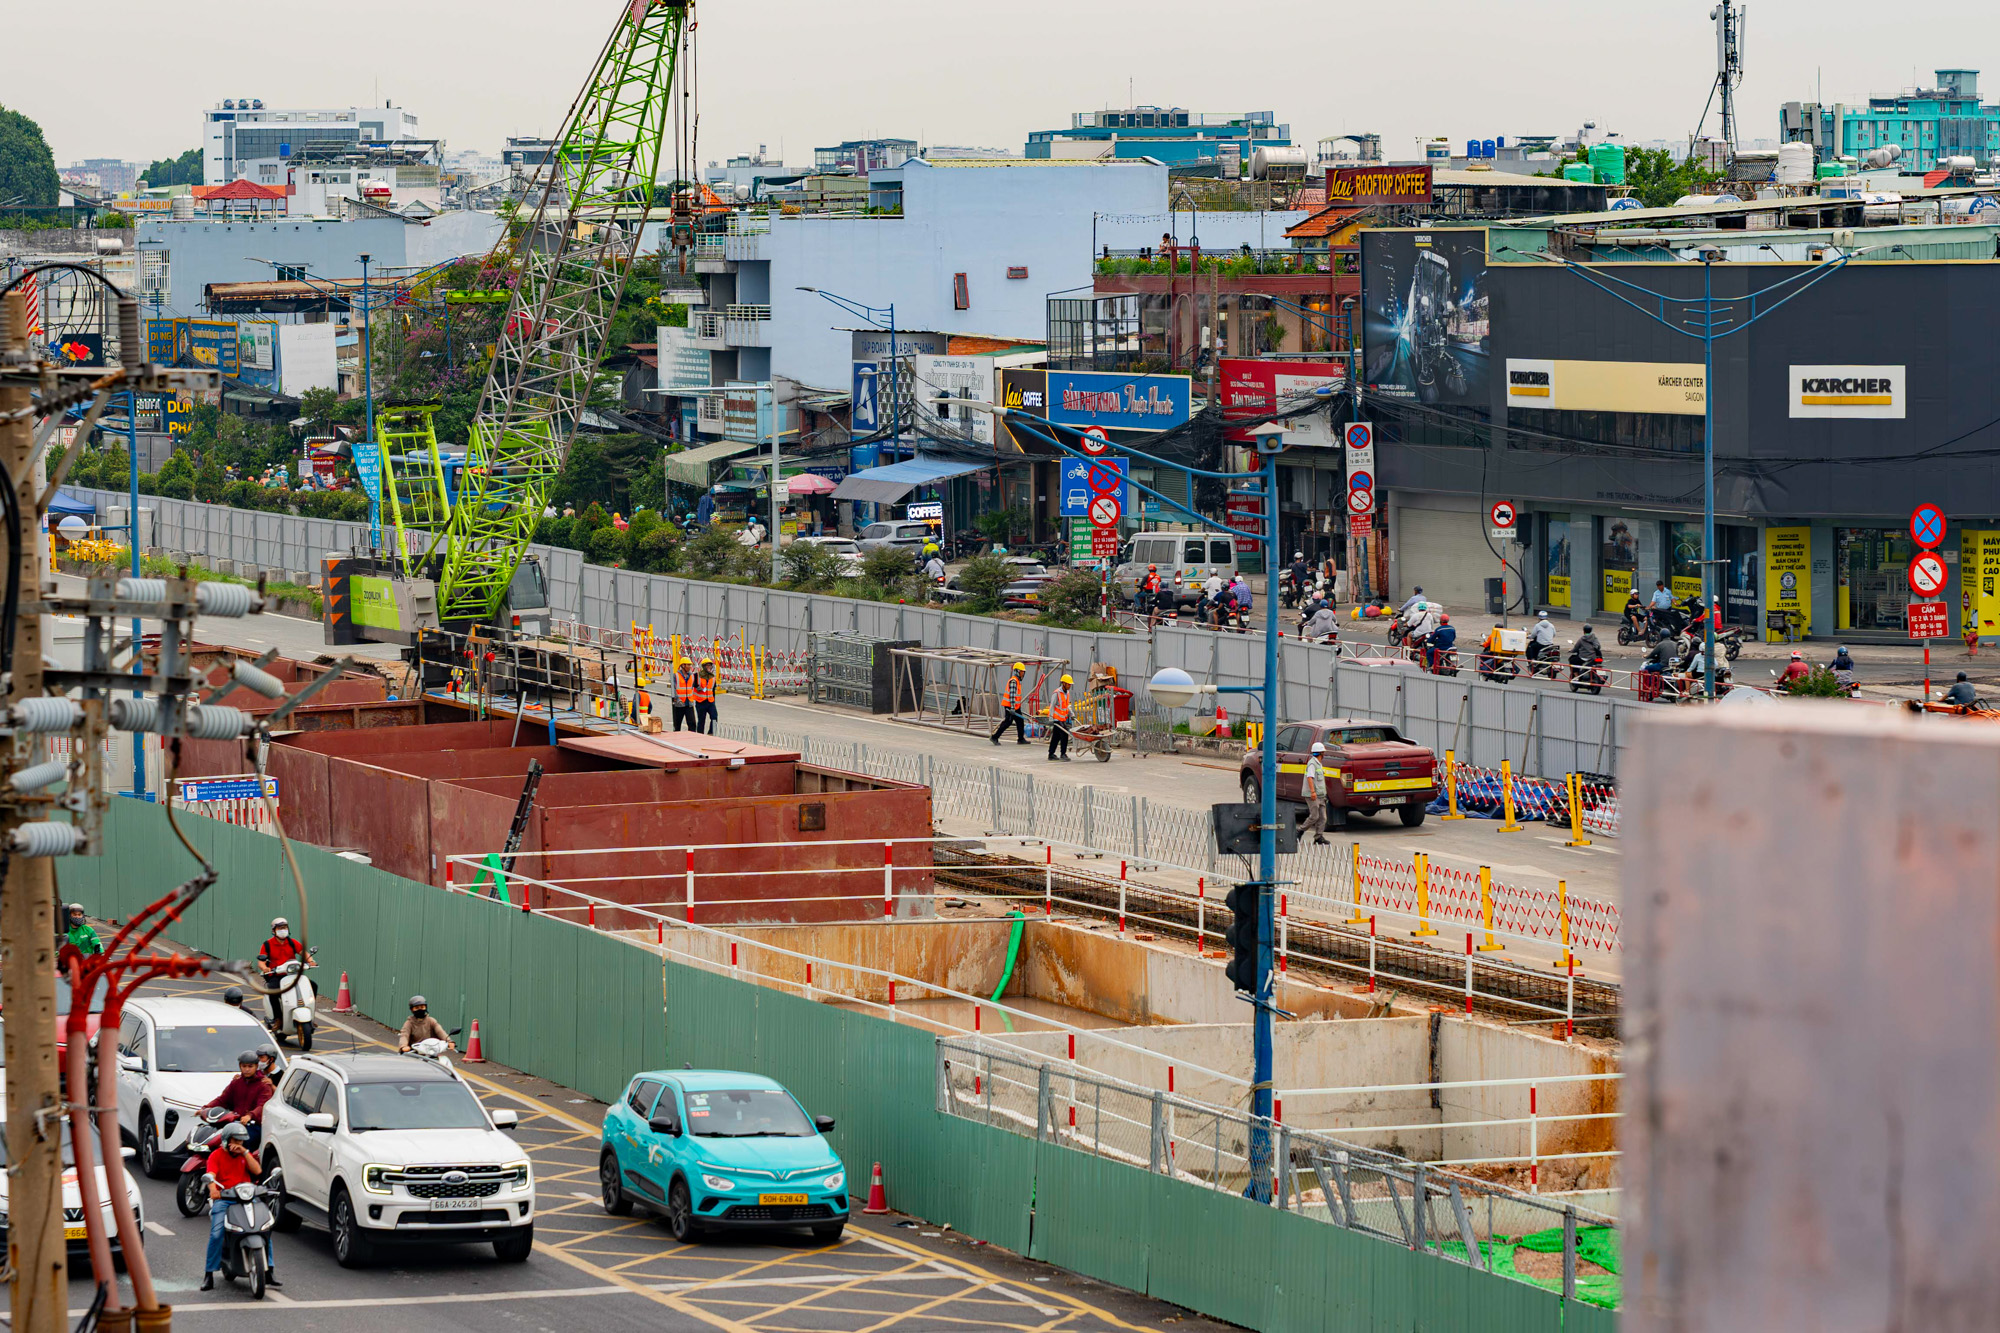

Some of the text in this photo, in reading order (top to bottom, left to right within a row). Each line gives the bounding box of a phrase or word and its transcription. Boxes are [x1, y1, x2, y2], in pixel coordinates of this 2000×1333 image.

[1356, 174, 1393, 196] ROOFTOP
[1394, 173, 1426, 195] COFFEE
[1683, 377, 1704, 388] CENTER
[1022, 391, 1043, 407] COFFEE
[1063, 382, 1080, 411] SẢN
[1080, 389, 1097, 418] PHỤ
[1097, 391, 1121, 413] KHOA
[1231, 391, 1245, 406] TÂN
[1685, 392, 1705, 402] SAIGON
[139, 401, 160, 410] SOFA
[909, 505, 942, 519] COFFEE
[1983, 556, 1994, 565] ÁP
[1983, 567, 1999, 575] CAO
[1984, 581, 1994, 589] 24
[1921, 604, 1936, 614] CẤM
[1934, 613, 1946, 621] BÁNH
[1356, 782, 1382, 790] SANY
